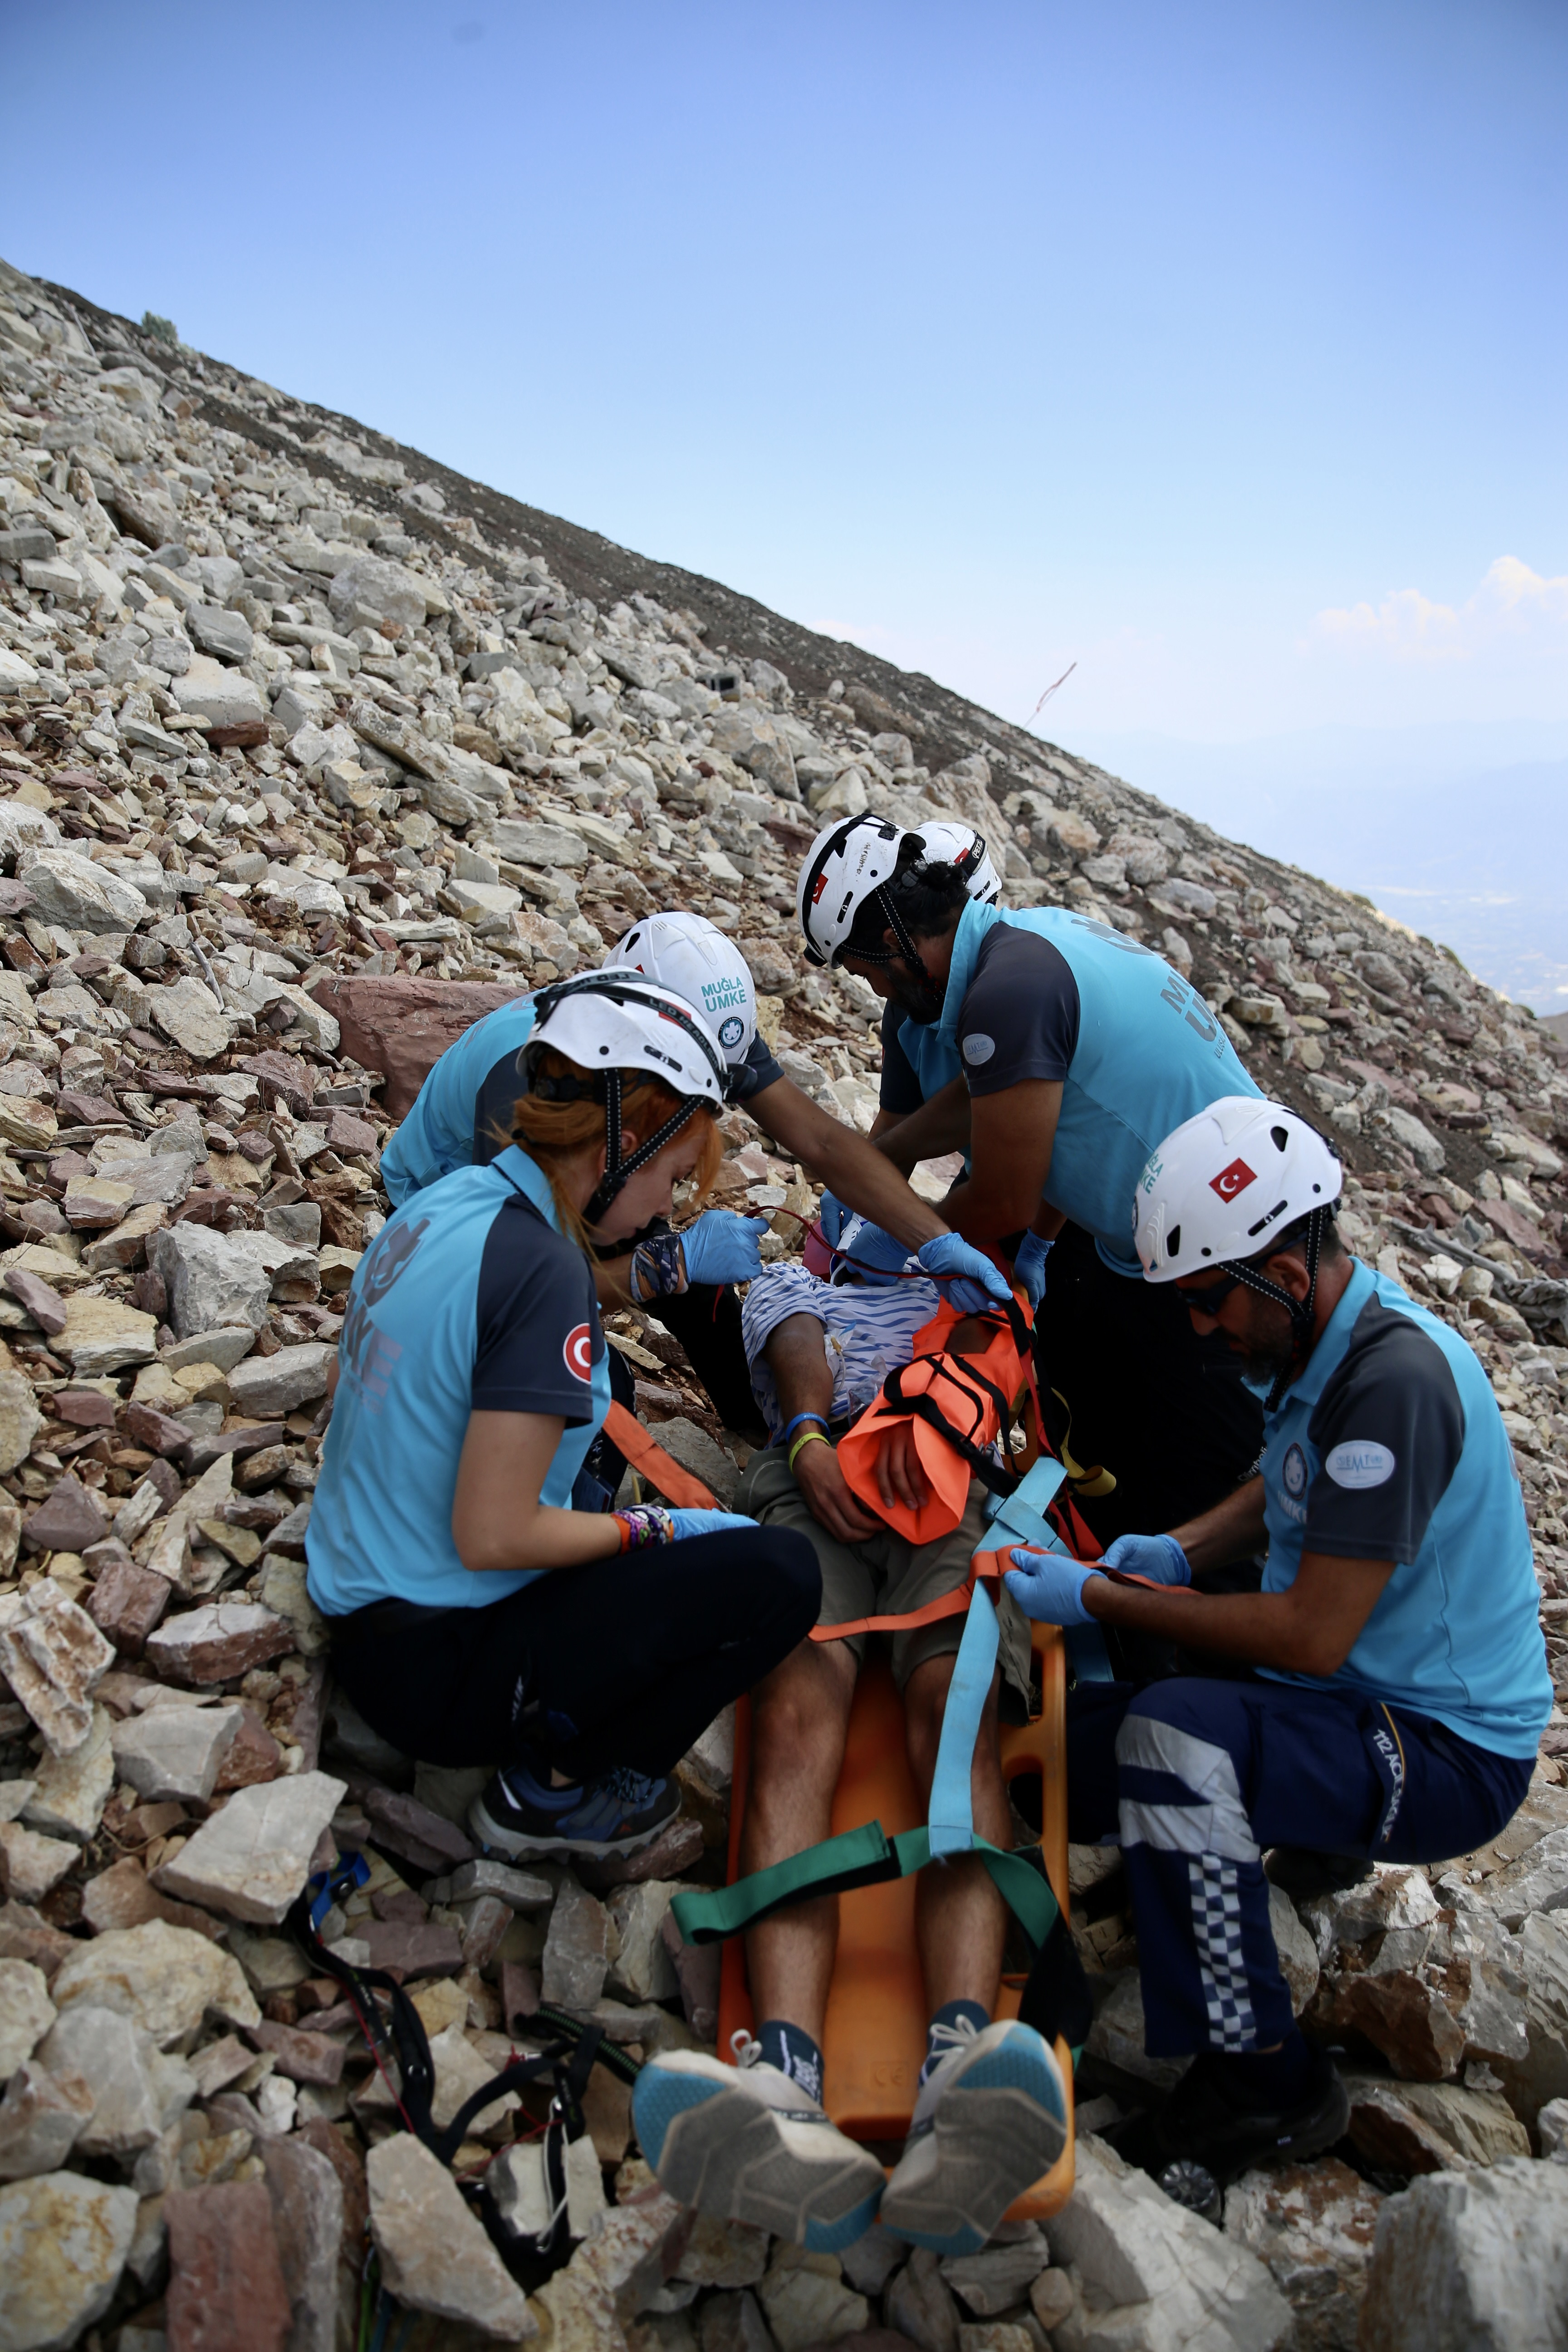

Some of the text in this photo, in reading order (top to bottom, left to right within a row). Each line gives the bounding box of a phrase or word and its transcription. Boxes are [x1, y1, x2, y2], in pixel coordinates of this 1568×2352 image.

[701, 976, 744, 997] MUĞLA
[649, 998, 677, 1016] LED
[705, 989, 747, 1012] UMKE
[1373, 1729, 1393, 1754] 112
